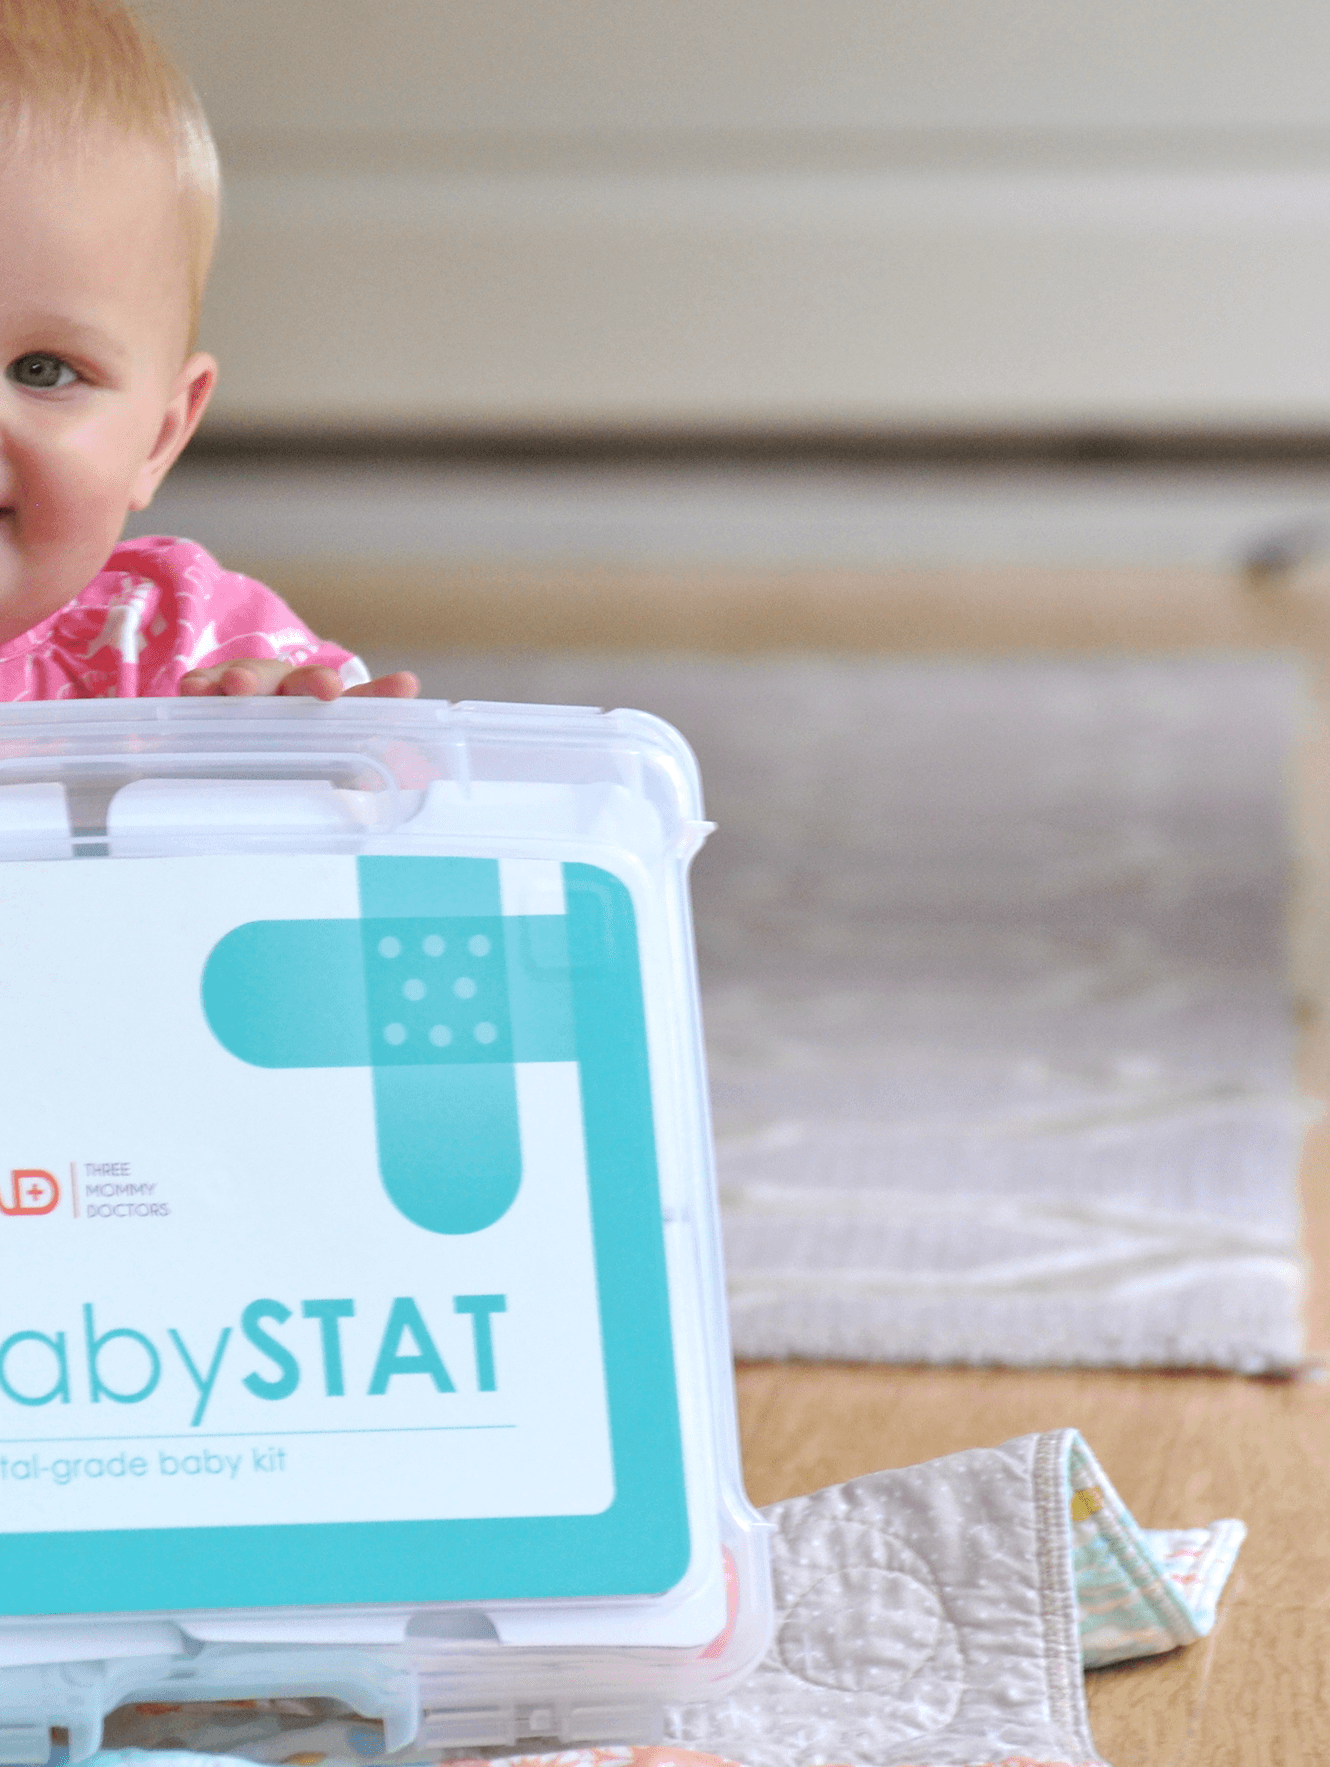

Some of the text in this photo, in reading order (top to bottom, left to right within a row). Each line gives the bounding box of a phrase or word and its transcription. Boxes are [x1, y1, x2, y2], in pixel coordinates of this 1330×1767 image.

[85, 1161, 131, 1178] THREE
[85, 1182, 157, 1199] MOMMY
[86, 1202, 171, 1219] DOCTORS
[159, 1448, 243, 1480] baby
[252, 1445, 288, 1474] kit
